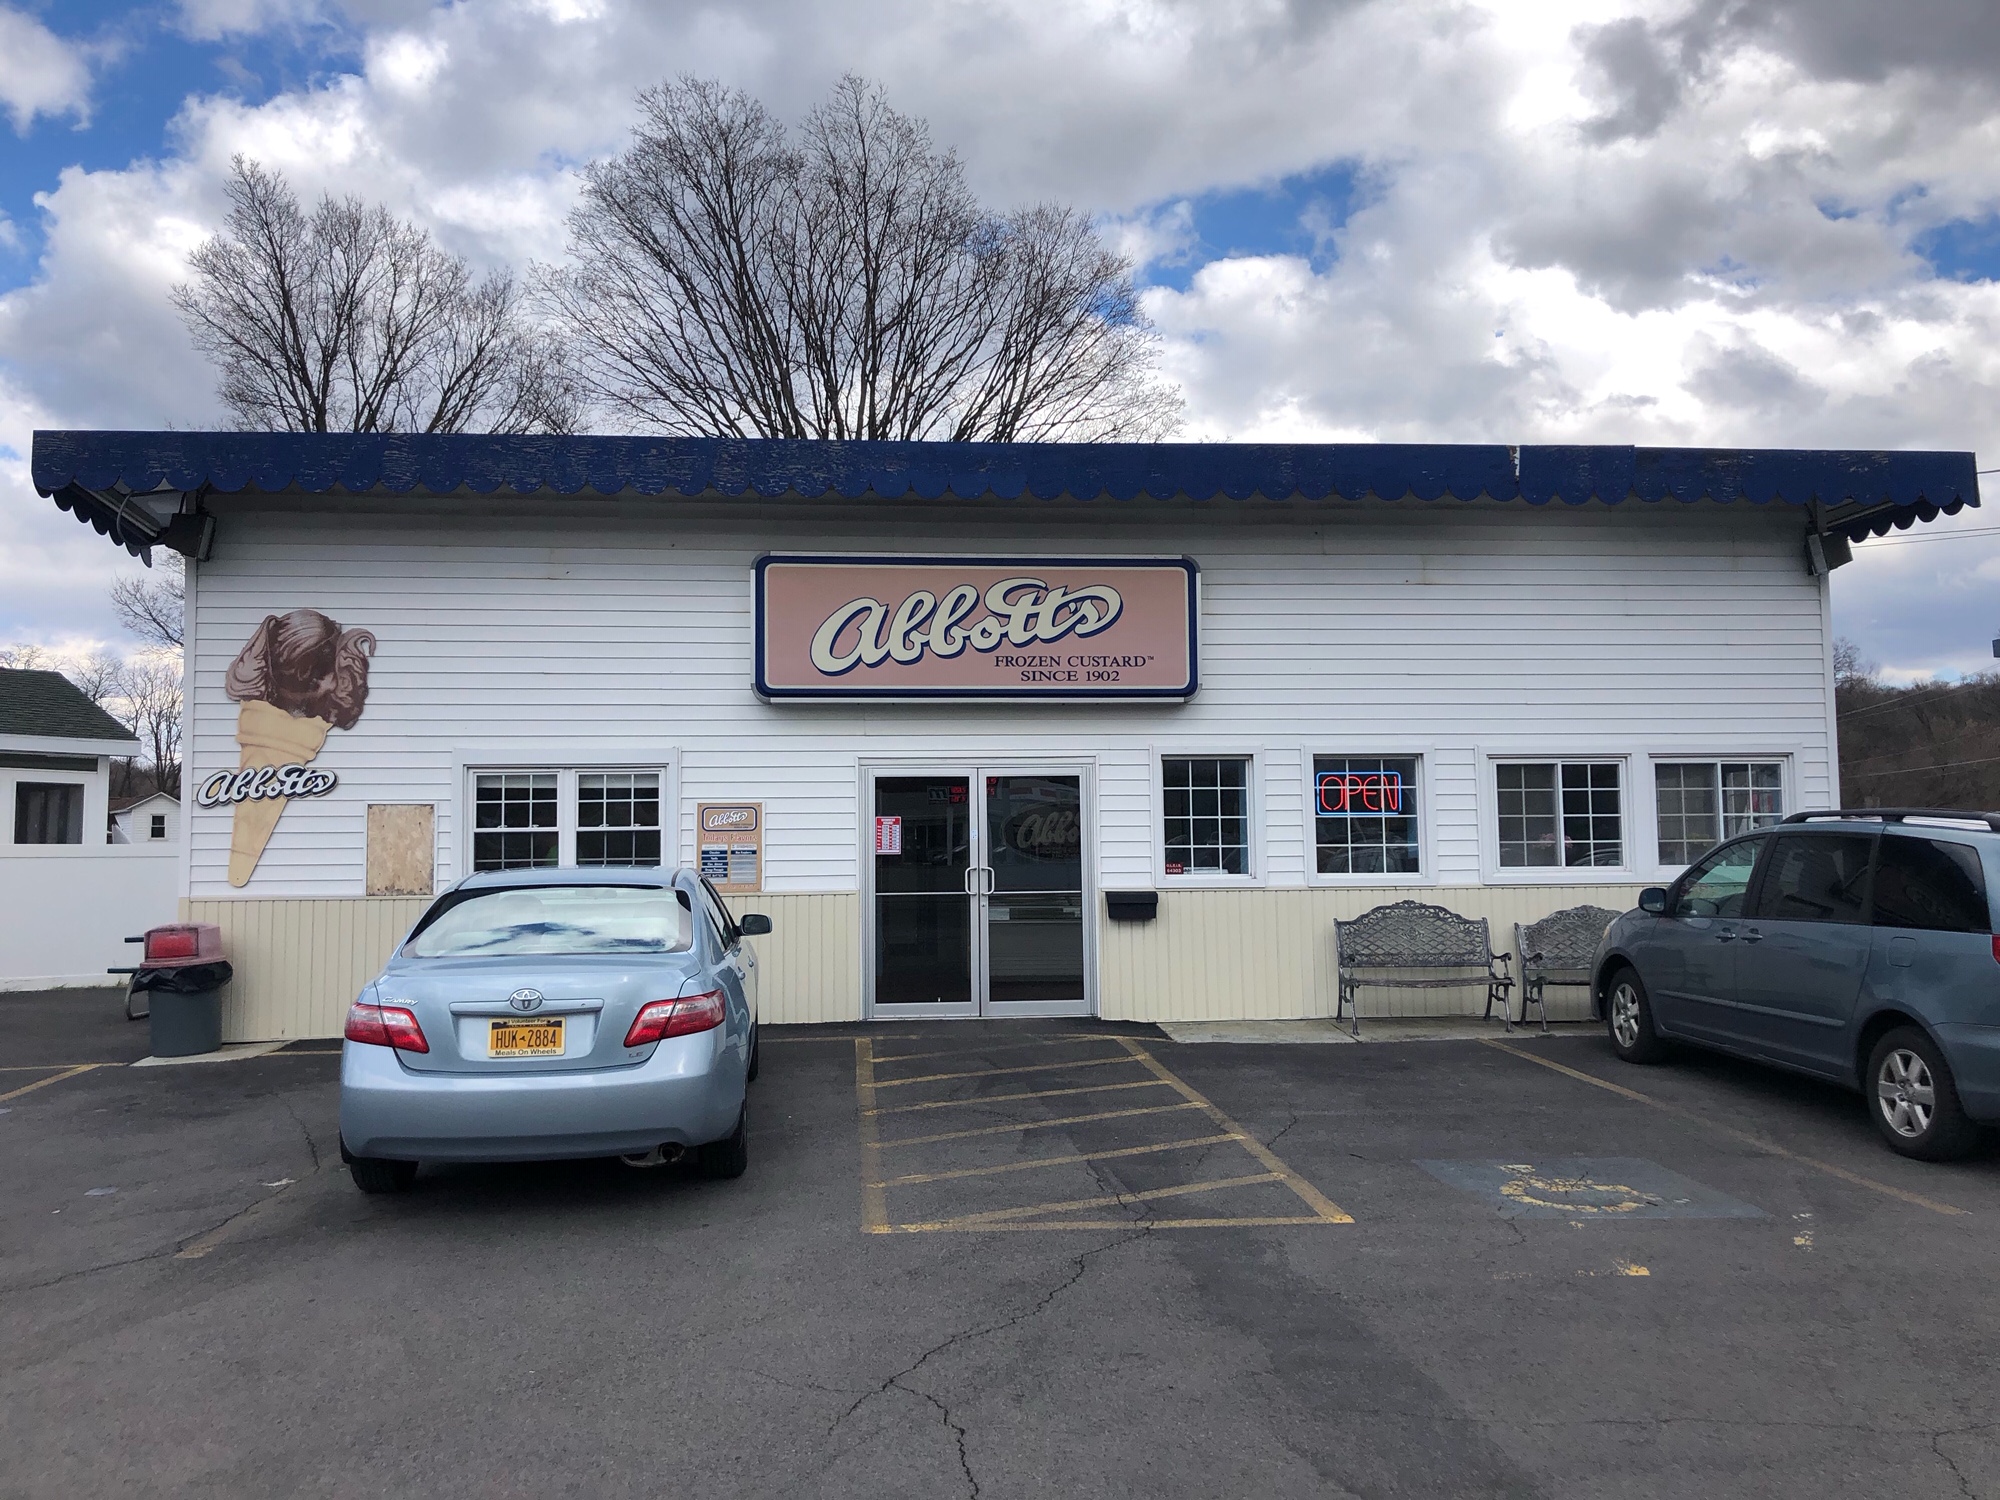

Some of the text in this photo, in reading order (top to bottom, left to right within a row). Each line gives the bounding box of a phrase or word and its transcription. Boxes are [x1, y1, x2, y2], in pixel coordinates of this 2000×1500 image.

[994, 655, 1062, 667] FROZEN
[1020, 670, 1120, 682] SINCE 1902
[1321, 776, 1398, 811] OPEN
